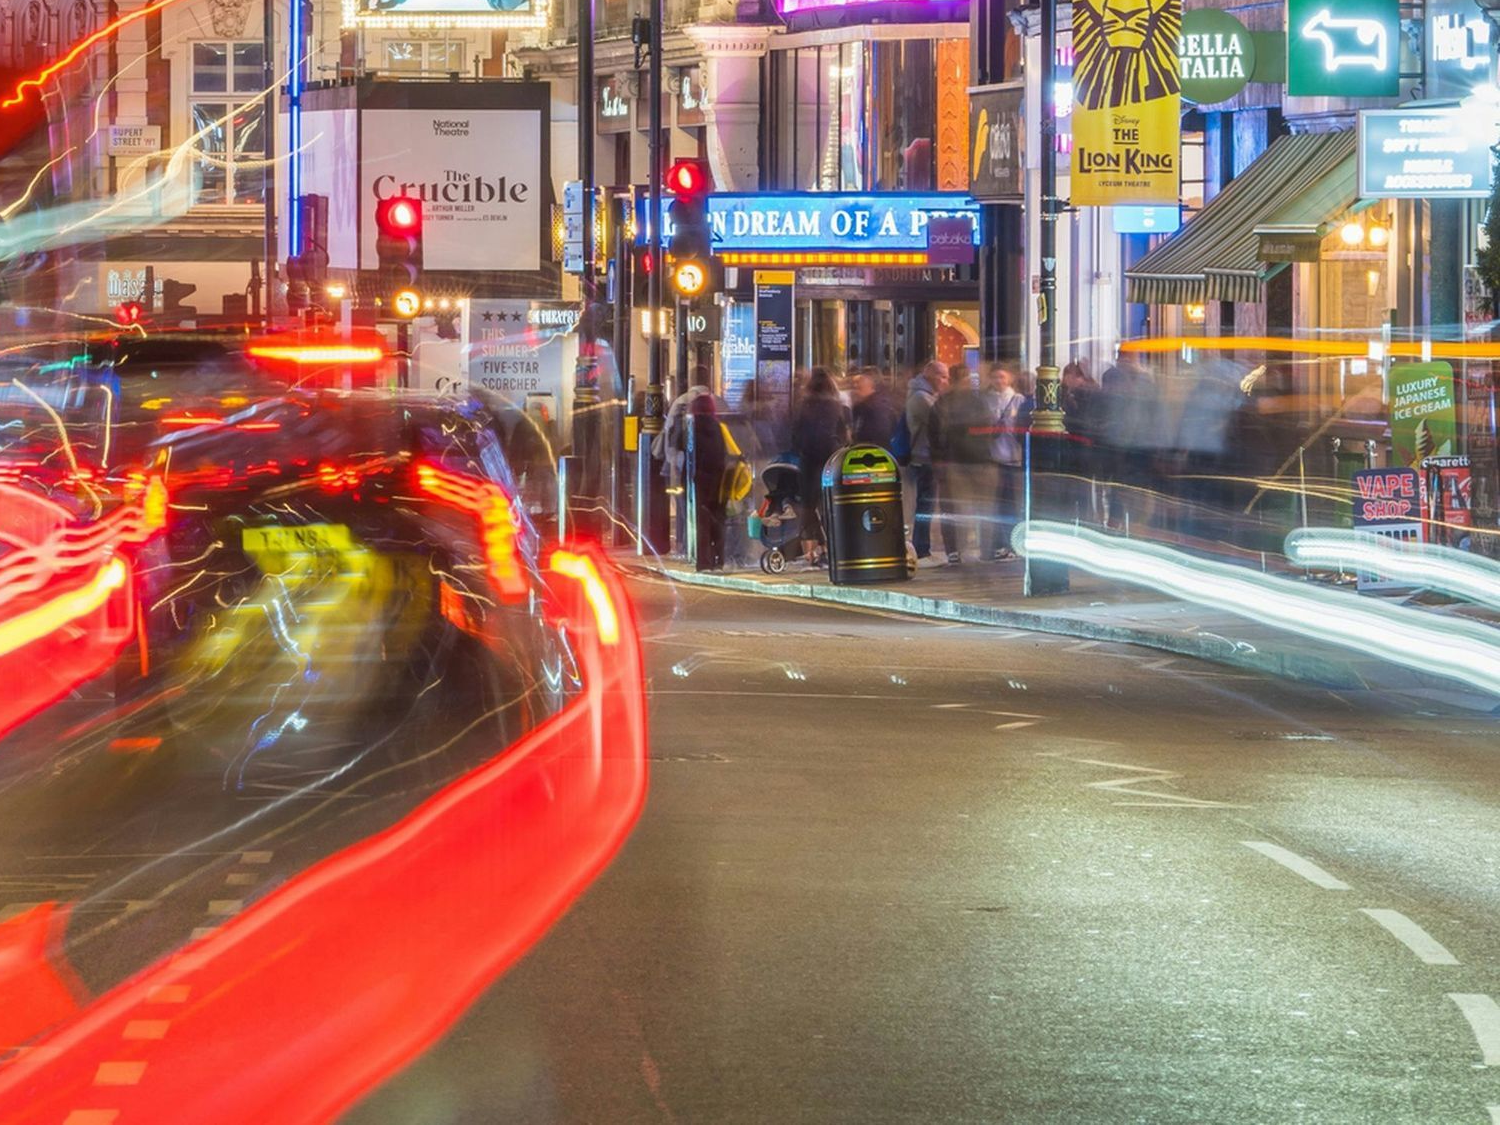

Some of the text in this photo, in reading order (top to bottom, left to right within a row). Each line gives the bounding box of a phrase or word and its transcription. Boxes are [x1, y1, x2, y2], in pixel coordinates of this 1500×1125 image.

[1180, 57, 1245, 79] TALIA
[113, 127, 143, 136] RUPERT
[433, 119, 470, 129] National
[434, 128, 470, 136] Theatre
[113, 138, 141, 146] STREET
[1113, 128, 1139, 141] THE
[444, 169, 470, 182] The
[372, 174, 528, 204] Crucible
[1124, 180, 1151, 188] THEATRE
[733, 210, 821, 236] DREAM
[830, 210, 869, 237] OF
[878, 210, 898, 236] A
[481, 328, 506, 341] THIS
[1396, 376, 1439, 396] LUXURY
[1394, 386, 1447, 409] JAPANESE
[1394, 398, 1452, 421] ICE CREAM
[1356, 474, 1415, 499] VAPE
[1363, 500, 1412, 521] SHOP
